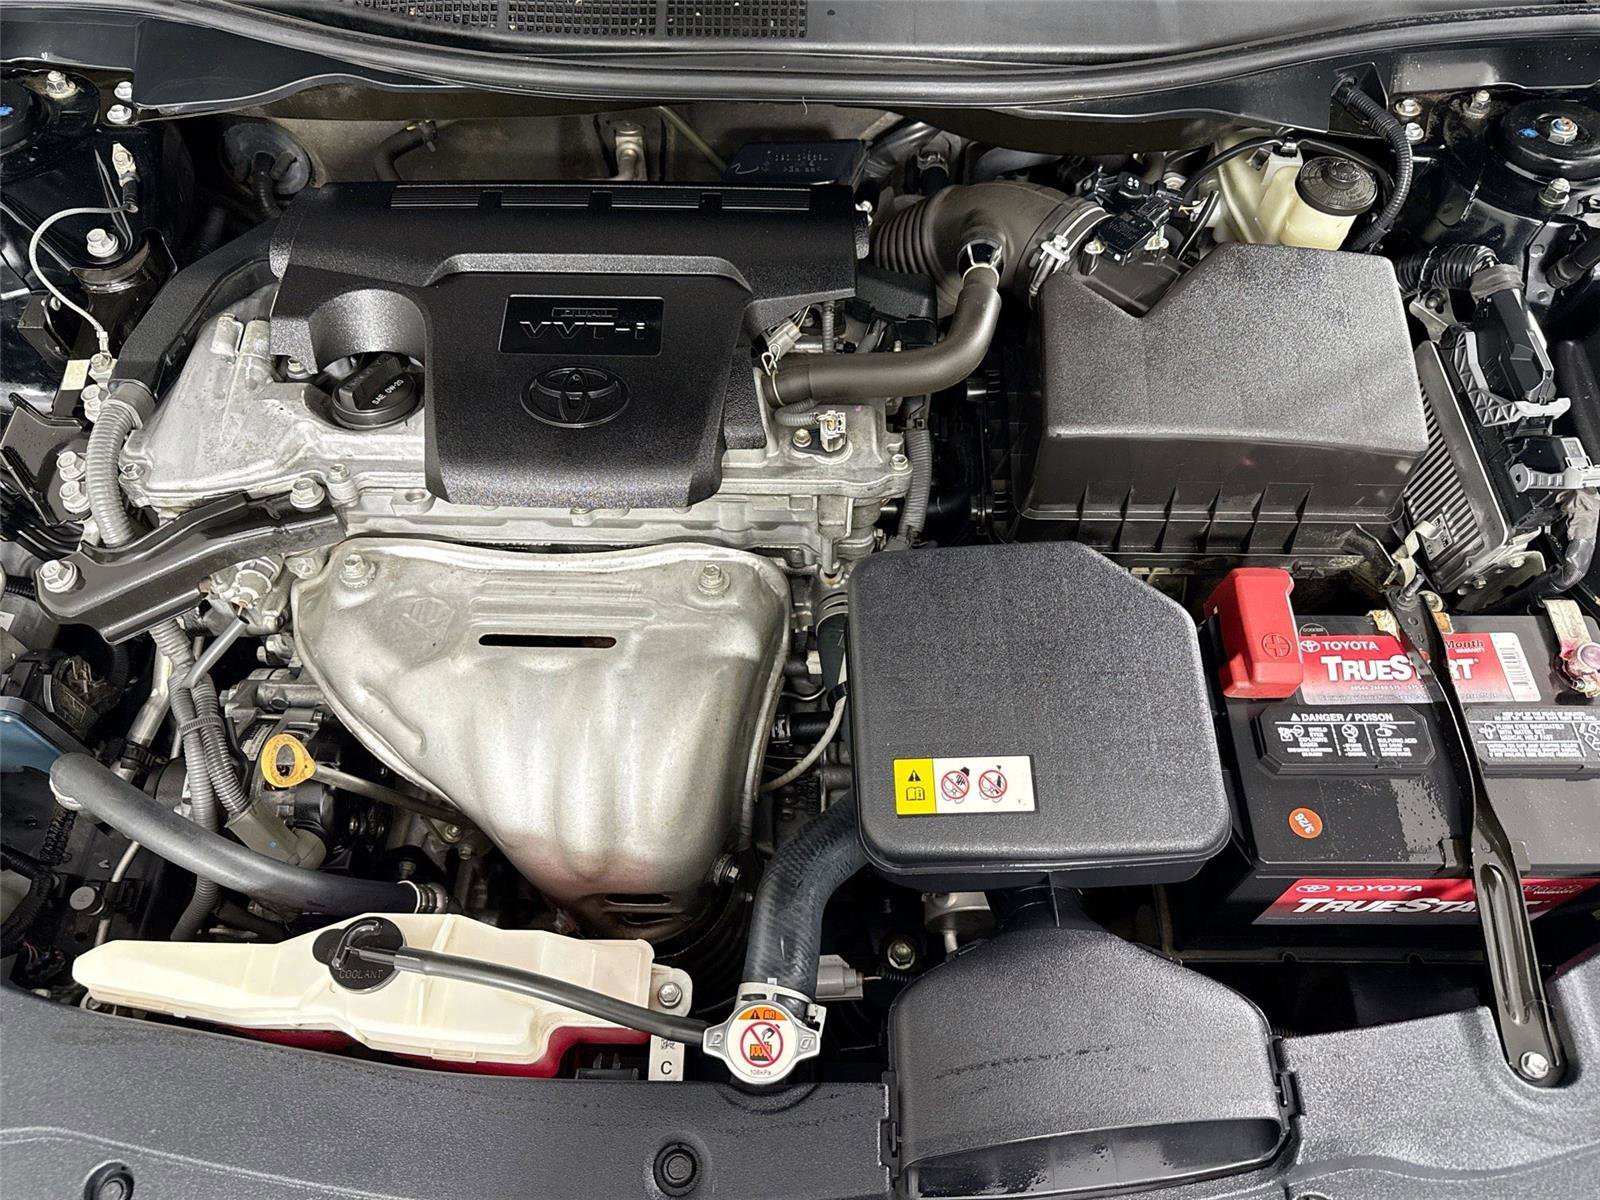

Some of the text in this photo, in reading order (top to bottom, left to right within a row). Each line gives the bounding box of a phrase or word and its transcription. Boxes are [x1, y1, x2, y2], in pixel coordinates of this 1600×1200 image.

[371, 379, 404, 405] SAE 0W-20
[1321, 640, 1380, 651] TOYOTA
[1301, 713, 1345, 722] DANGER
[1355, 713, 1394, 722] POISON
[339, 969, 384, 979] COOLANT
[660, 1060, 673, 1076] C
